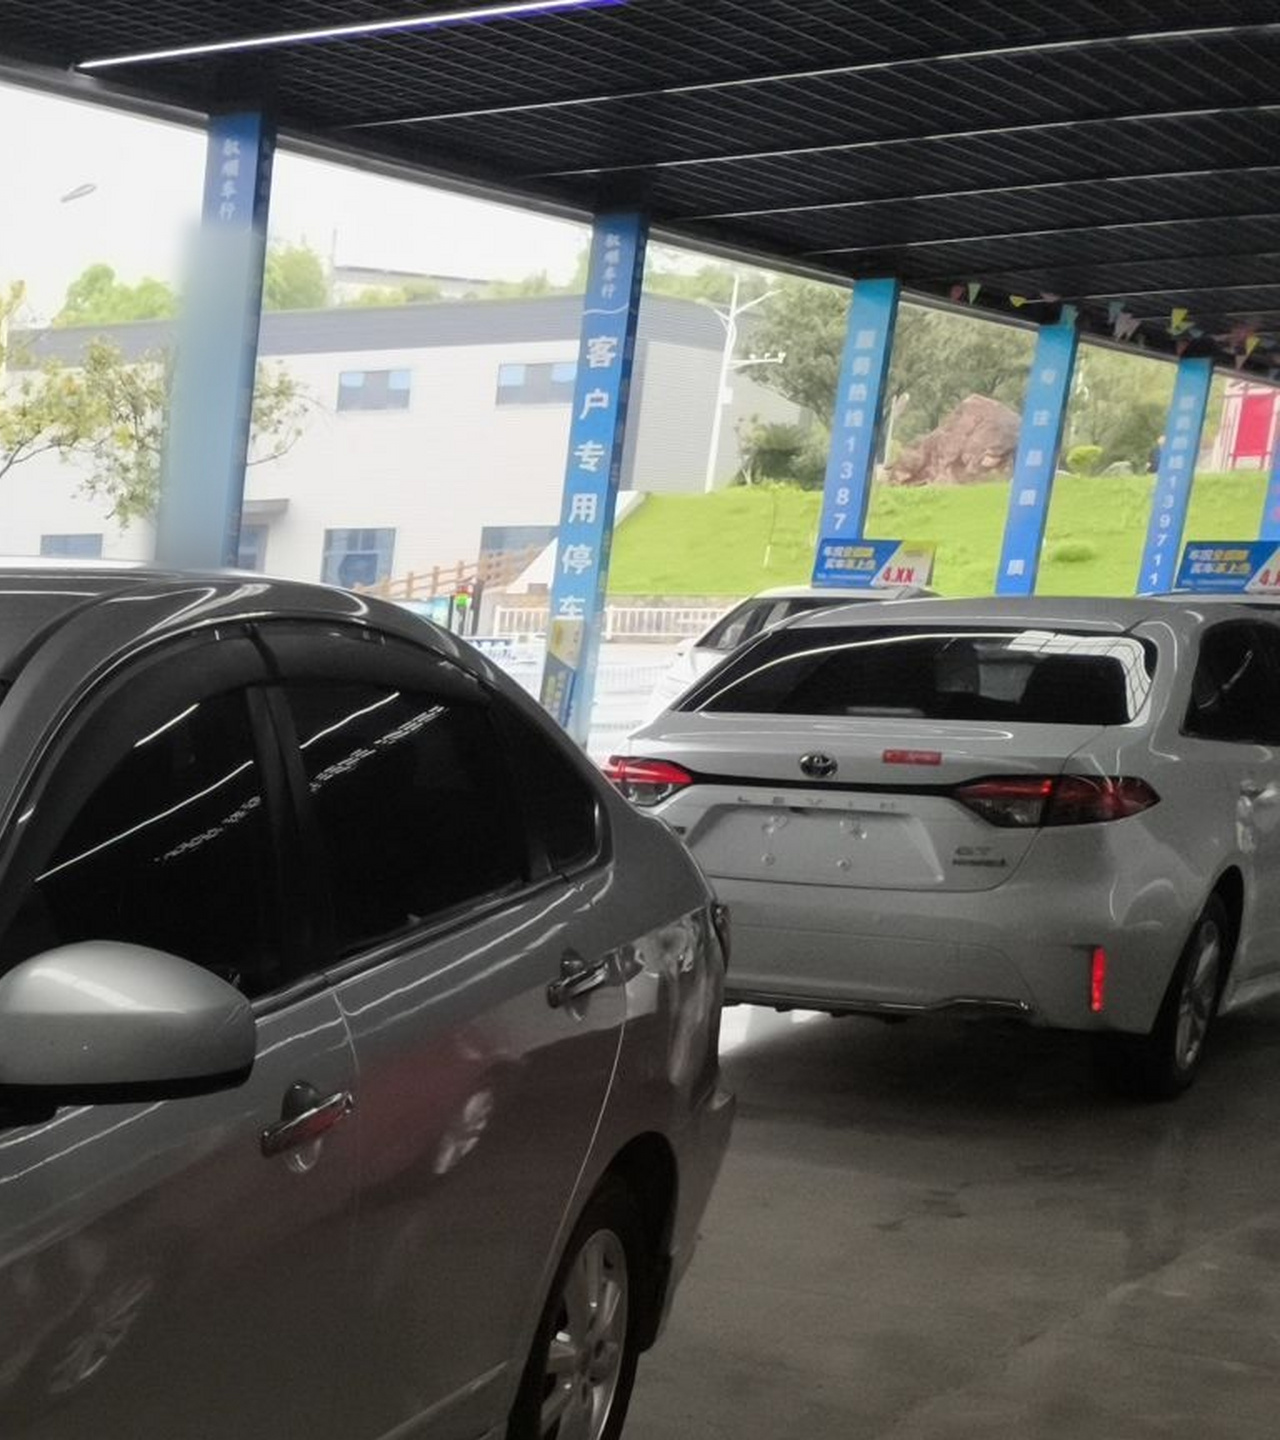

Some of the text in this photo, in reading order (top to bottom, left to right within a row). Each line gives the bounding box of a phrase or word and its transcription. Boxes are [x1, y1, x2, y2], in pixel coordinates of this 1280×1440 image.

[559, 337, 617, 619] 客户专用停车
